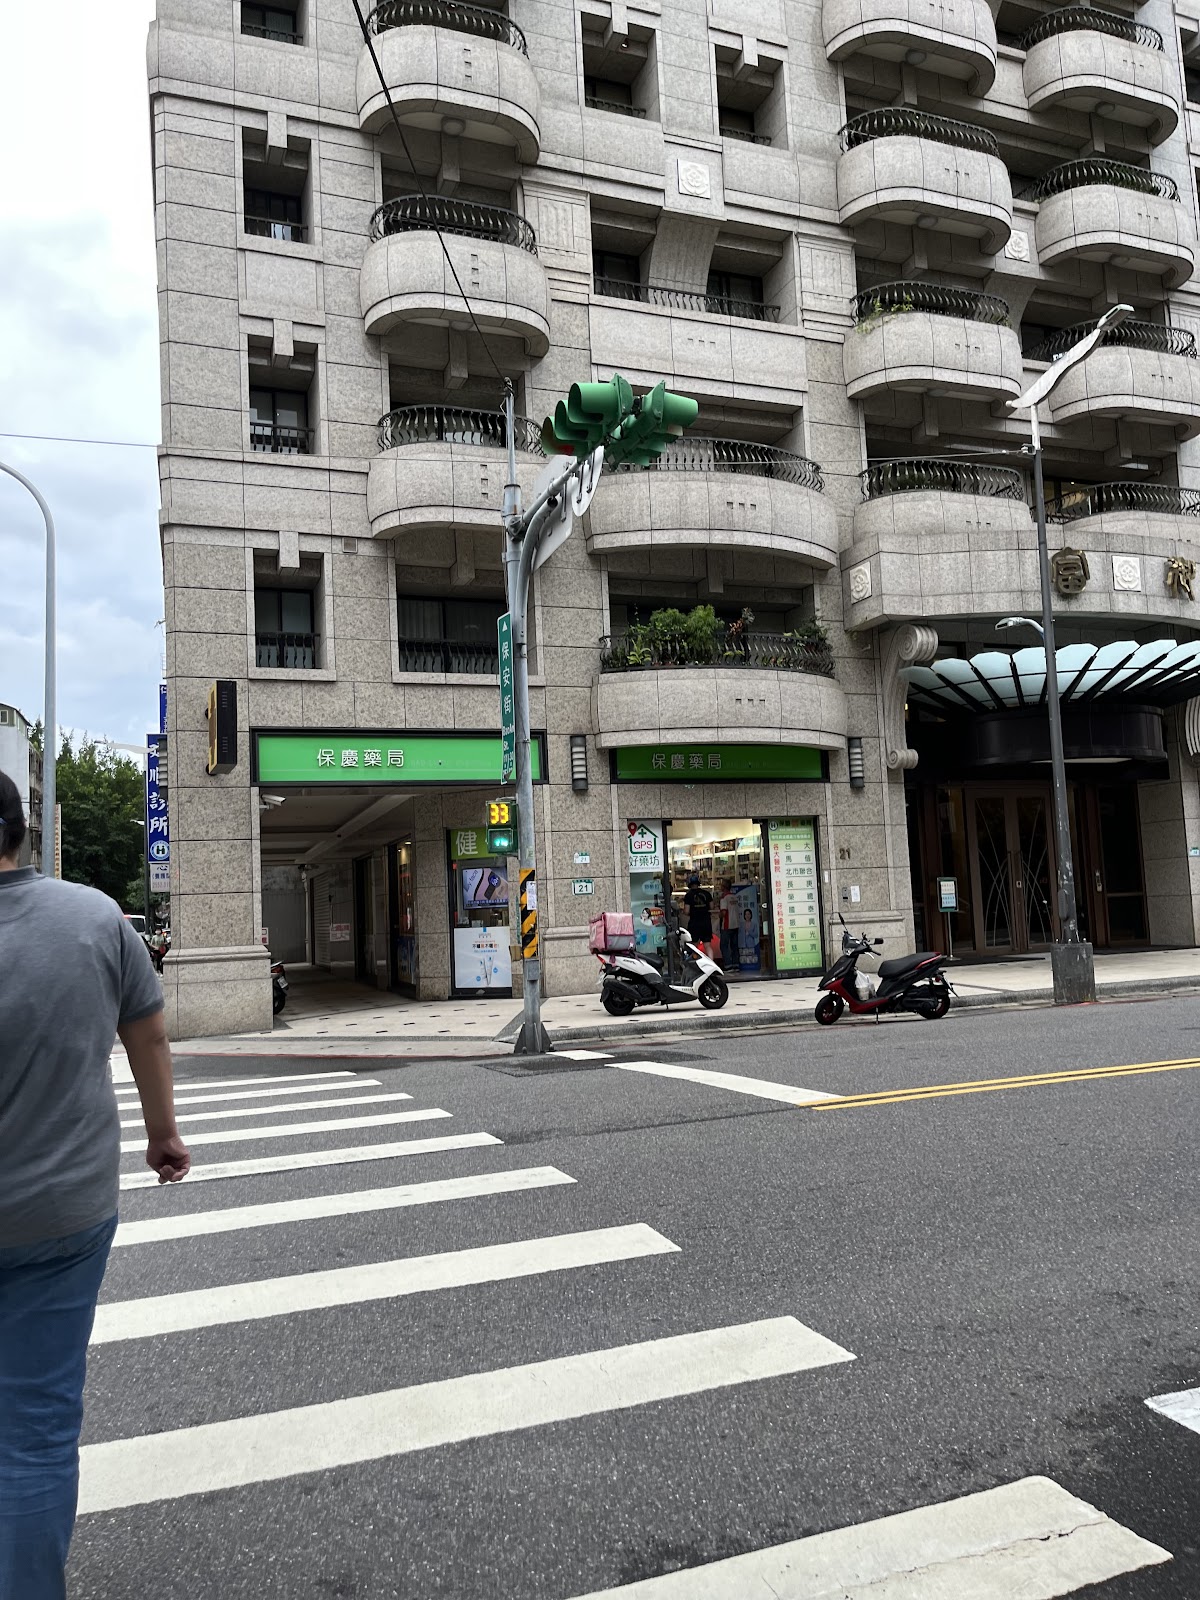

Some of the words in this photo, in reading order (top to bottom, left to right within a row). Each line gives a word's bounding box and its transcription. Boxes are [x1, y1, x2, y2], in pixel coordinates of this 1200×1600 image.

[502, 641, 512, 715] 保安街
[316, 748, 405, 768] 保慶藥局
[652, 753, 722, 770] 保慶藥局
[490, 803, 509, 824] 33
[456, 831, 478, 856] 健
[633, 840, 653, 850] GPS
[629, 855, 660, 867] 好藥坊
[840, 847, 851, 860] 21
[578, 884, 588, 893] 21
